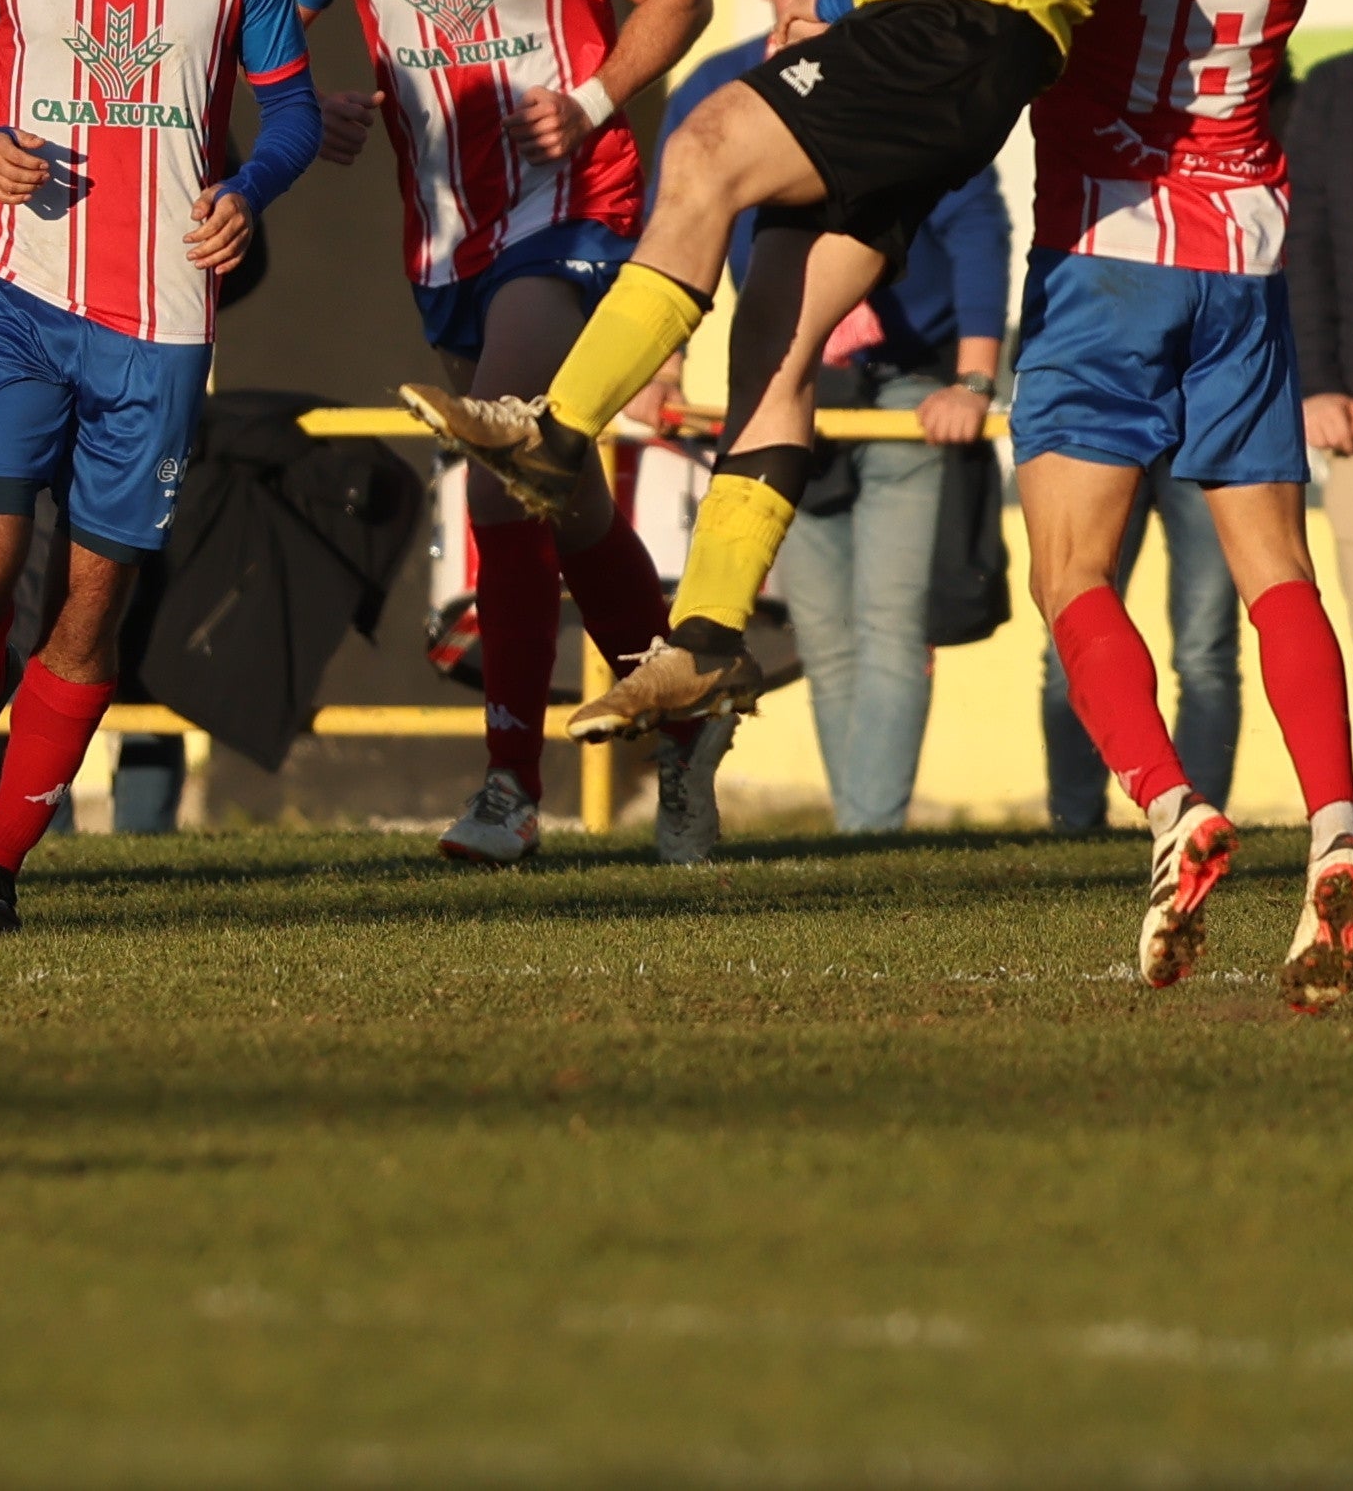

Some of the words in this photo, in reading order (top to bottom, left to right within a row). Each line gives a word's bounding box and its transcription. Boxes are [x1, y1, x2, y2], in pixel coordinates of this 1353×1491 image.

[397, 47, 452, 69] CAJA
[455, 33, 542, 63] RURAL
[32, 99, 99, 126] CAJA
